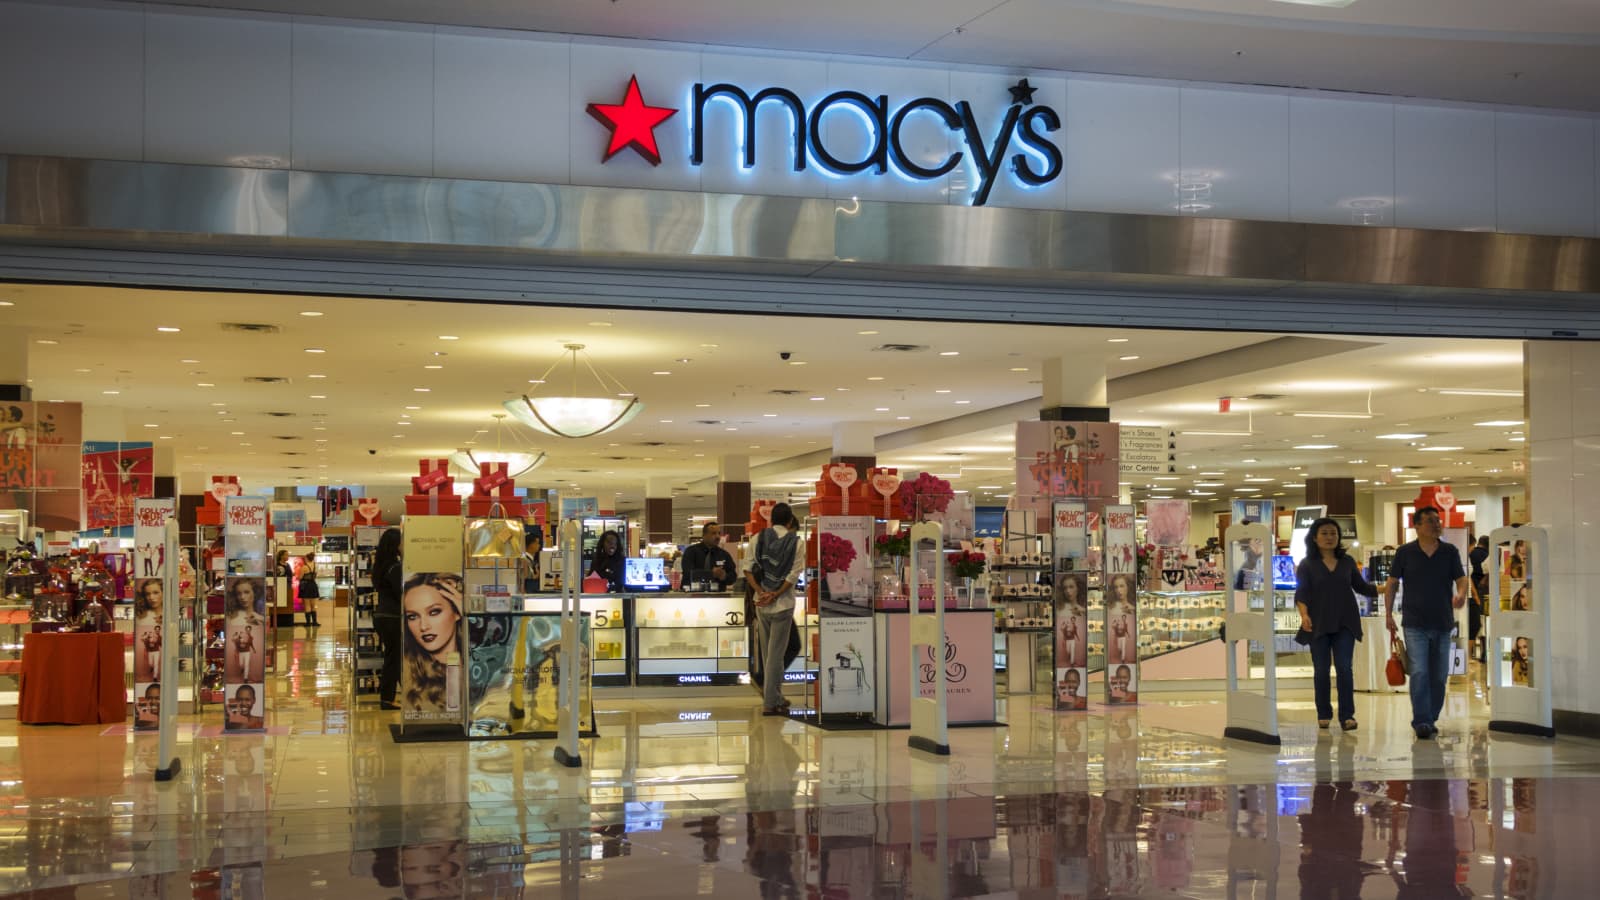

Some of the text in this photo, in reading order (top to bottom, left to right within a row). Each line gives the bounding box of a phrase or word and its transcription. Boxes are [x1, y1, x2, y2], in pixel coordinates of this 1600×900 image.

[1135, 464, 1160, 472] Center
[1040, 480, 1102, 496] HEART
[140, 507, 173, 515] FOLLOW
[232, 505, 265, 514] FOLLOW
[137, 512, 163, 521] YOUR
[229, 511, 255, 519] YOUR
[1056, 514, 1078, 523] YOUR
[232, 518, 263, 526] HEART
[1059, 521, 1084, 529] HEART
[1109, 522, 1132, 530] HEART
[595, 610, 609, 627] 5
